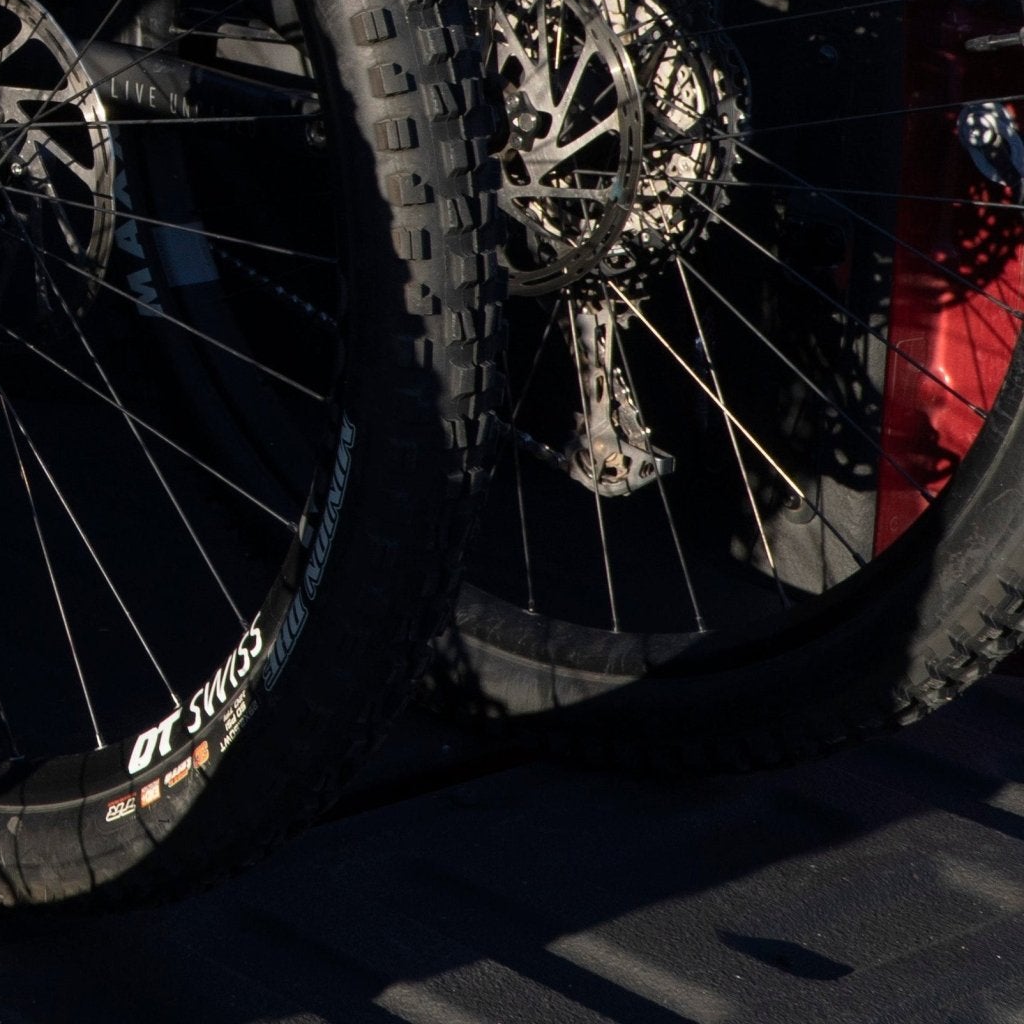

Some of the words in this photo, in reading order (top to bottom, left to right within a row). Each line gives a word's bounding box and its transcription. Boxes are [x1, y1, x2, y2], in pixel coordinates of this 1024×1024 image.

[110, 77, 157, 109] LIVE
[304, 410, 355, 600] MINION
[128, 707, 183, 775] DT
[187, 611, 263, 734] SWISS
